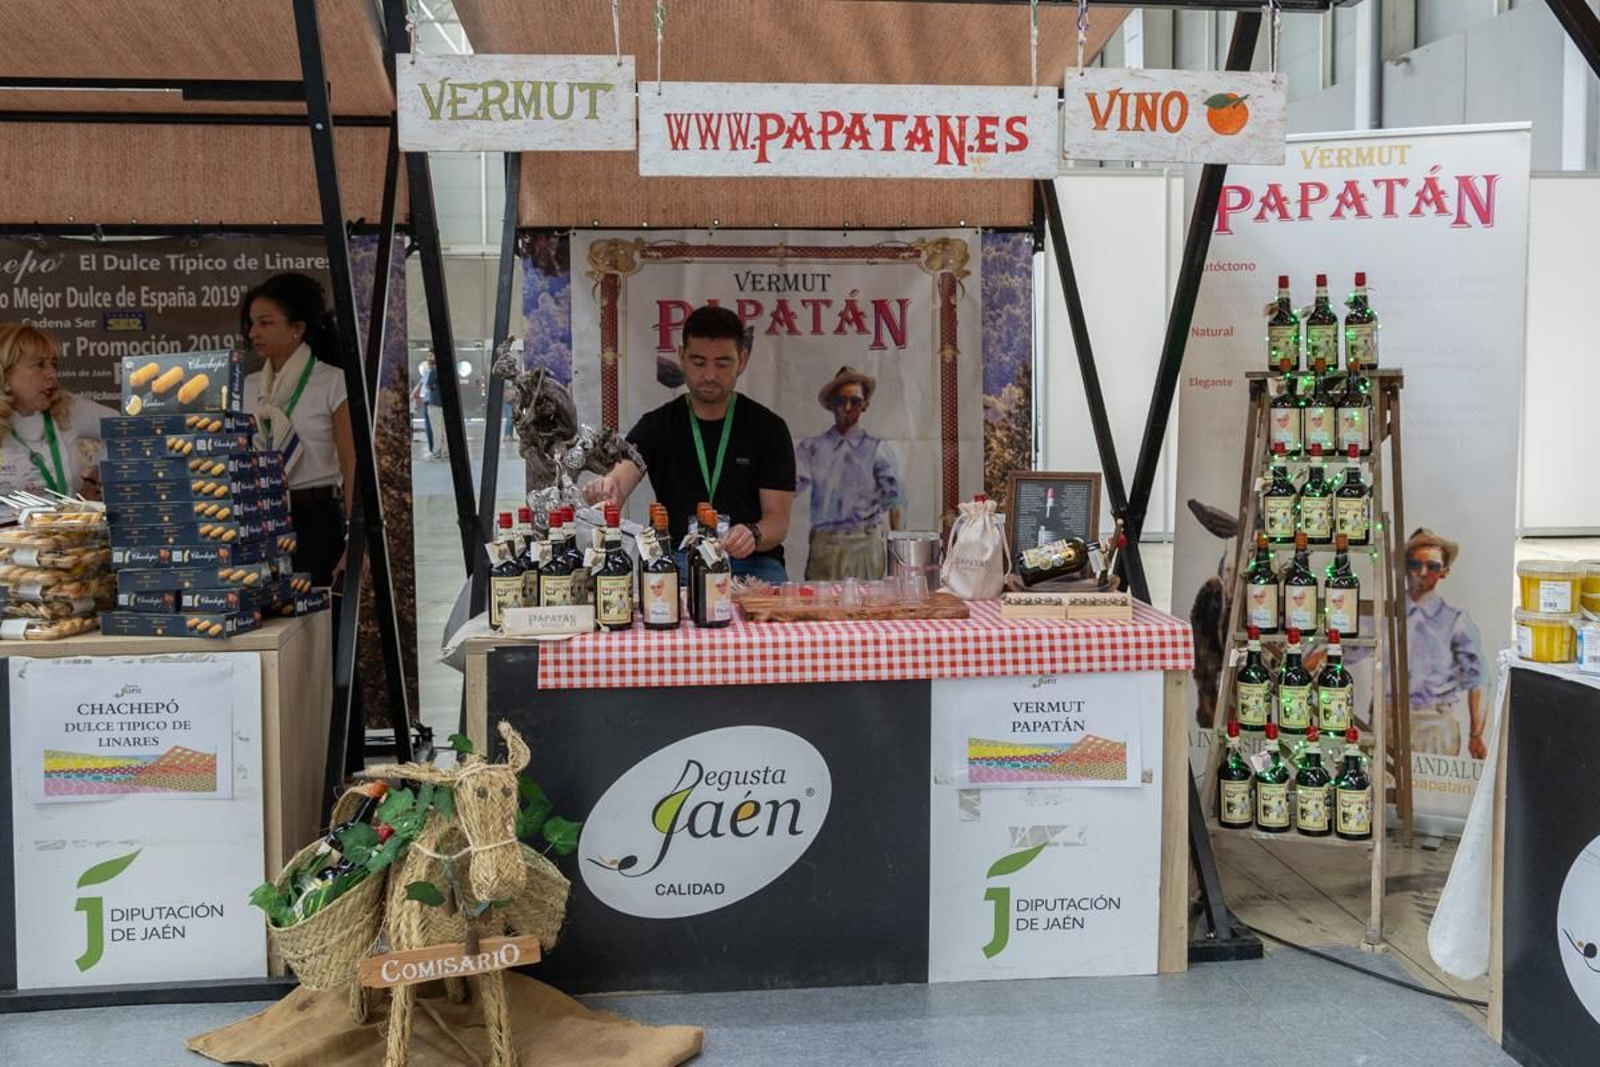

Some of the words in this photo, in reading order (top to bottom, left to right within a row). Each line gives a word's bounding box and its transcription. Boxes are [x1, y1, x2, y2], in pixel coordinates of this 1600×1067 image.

[418, 77, 616, 121] VERMUT
[1085, 88, 1189, 135] VINO
[664, 111, 1029, 166] WWW.PAPATAN.ES
[1299, 143, 1412, 170] VERMUT
[1214, 164, 1502, 235] PAPATÁN
[79, 254, 97, 271] El
[103, 253, 161, 271] Dulce
[165, 253, 228, 275] Típico
[233, 253, 259, 270] de
[1202, 260, 1256, 271] utóctono
[734, 271, 832, 293] VERMUT
[13, 286, 62, 314] Mejor
[66, 285, 112, 308] Dulce
[116, 285, 136, 307] de
[140, 285, 196, 314] España
[201, 285, 248, 307] 2019"
[74, 317, 98, 328] Ser
[652, 289, 914, 352] PPATÁN
[1191, 326, 1234, 337] Natural
[76, 335, 181, 357] Promoción
[1189, 377, 1234, 389] Elegante
[77, 698, 180, 716] CHACHEPÓ
[1013, 701, 1085, 713] VERMUT
[64, 721, 115, 733] DULCE
[117, 720, 167, 732] TIPICO
[172, 720, 192, 731] DE
[1012, 717, 1086, 733] PAPATÁN
[98, 736, 160, 748] LINARES
[672, 759, 786, 791] Degusta
[655, 883, 725, 896] CALIDAD
[110, 901, 224, 922] DIPUTACIÓN
[1016, 895, 1121, 912] DIPUTACIÓN
[111, 928, 135, 942] DE
[140, 923, 186, 941] JAÉN
[1016, 918, 1039, 931] DE
[1043, 914, 1085, 931] JAÉN
[381, 943, 520, 982] COMISARIO
